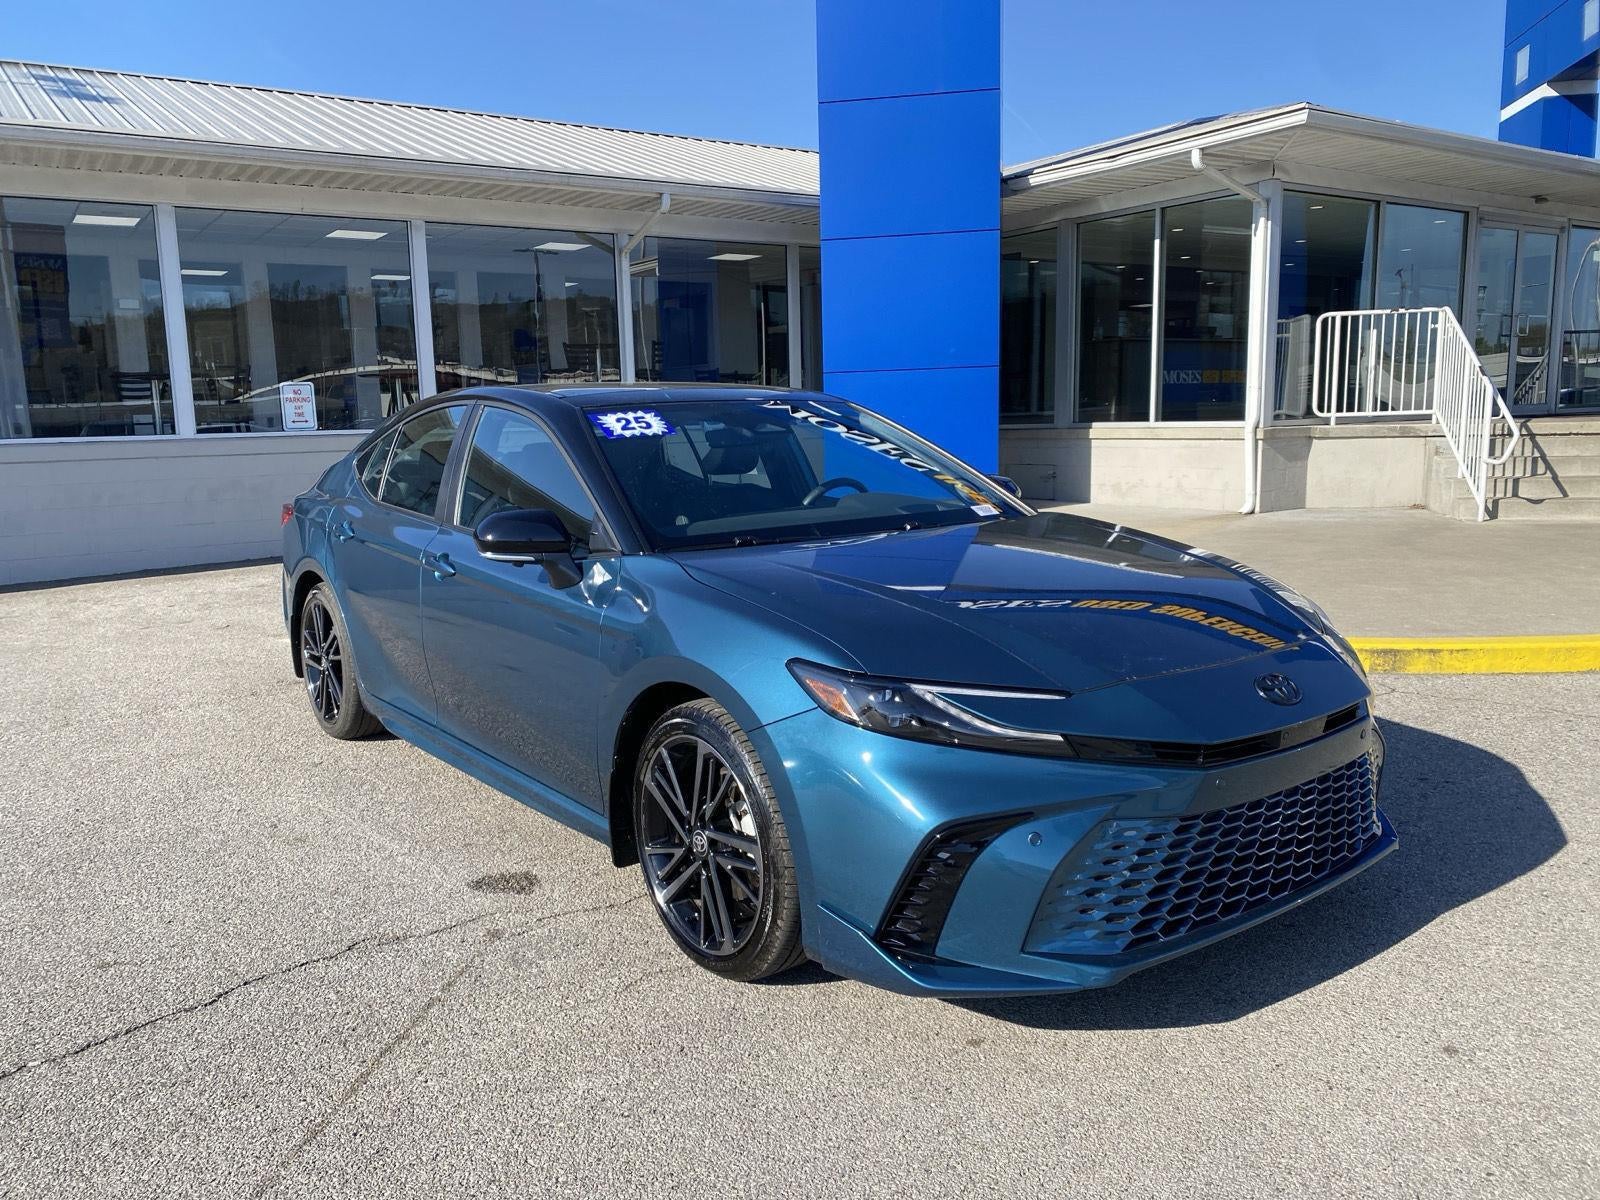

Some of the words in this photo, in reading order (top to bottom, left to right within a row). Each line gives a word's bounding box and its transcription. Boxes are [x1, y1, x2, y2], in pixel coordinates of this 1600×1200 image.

[1163, 370, 1202, 384] MOSES
[285, 396, 311, 404] PARKING
[615, 416, 653, 431] 25
